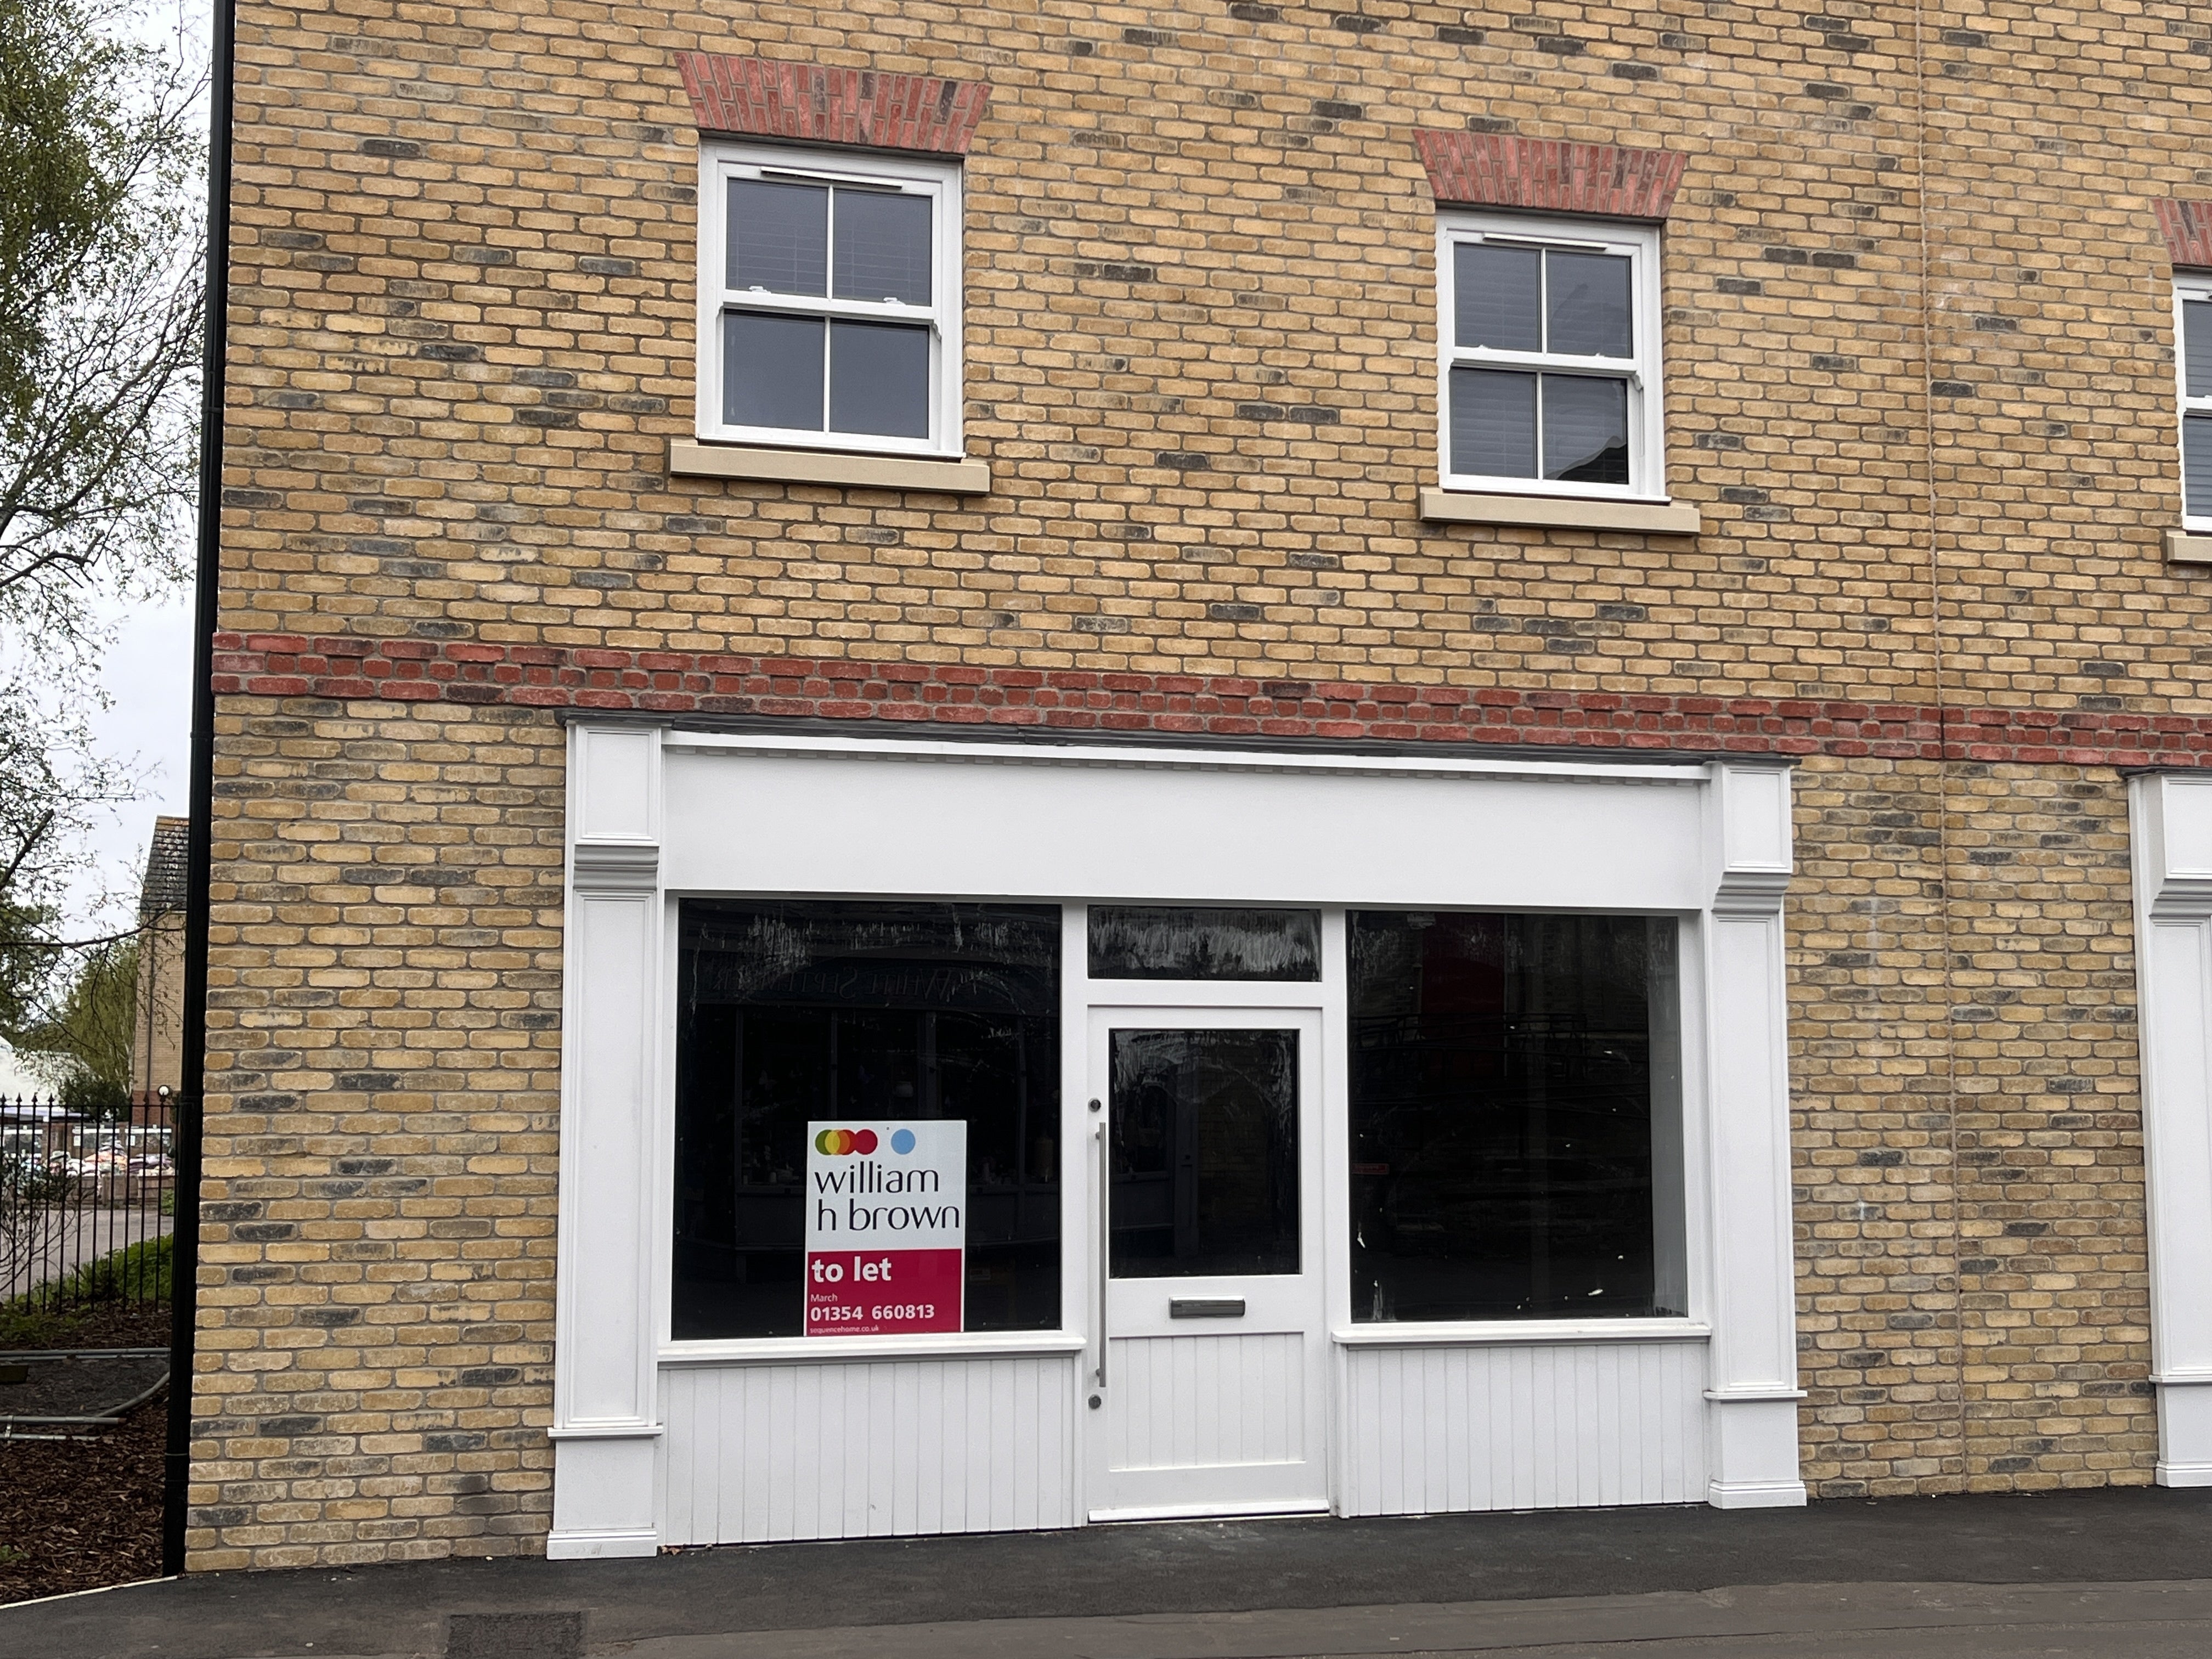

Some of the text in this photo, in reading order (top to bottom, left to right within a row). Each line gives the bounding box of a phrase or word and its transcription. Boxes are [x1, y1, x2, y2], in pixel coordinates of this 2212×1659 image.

[815, 1161, 938, 1194] william
[818, 1198, 959, 1231] h brown
[812, 1256, 891, 1282] to let
[811, 1293, 837, 1302] March
[811, 1305, 934, 1321] 01354 660813
[810, 1325, 879, 1334] sequencehome.co.uk
